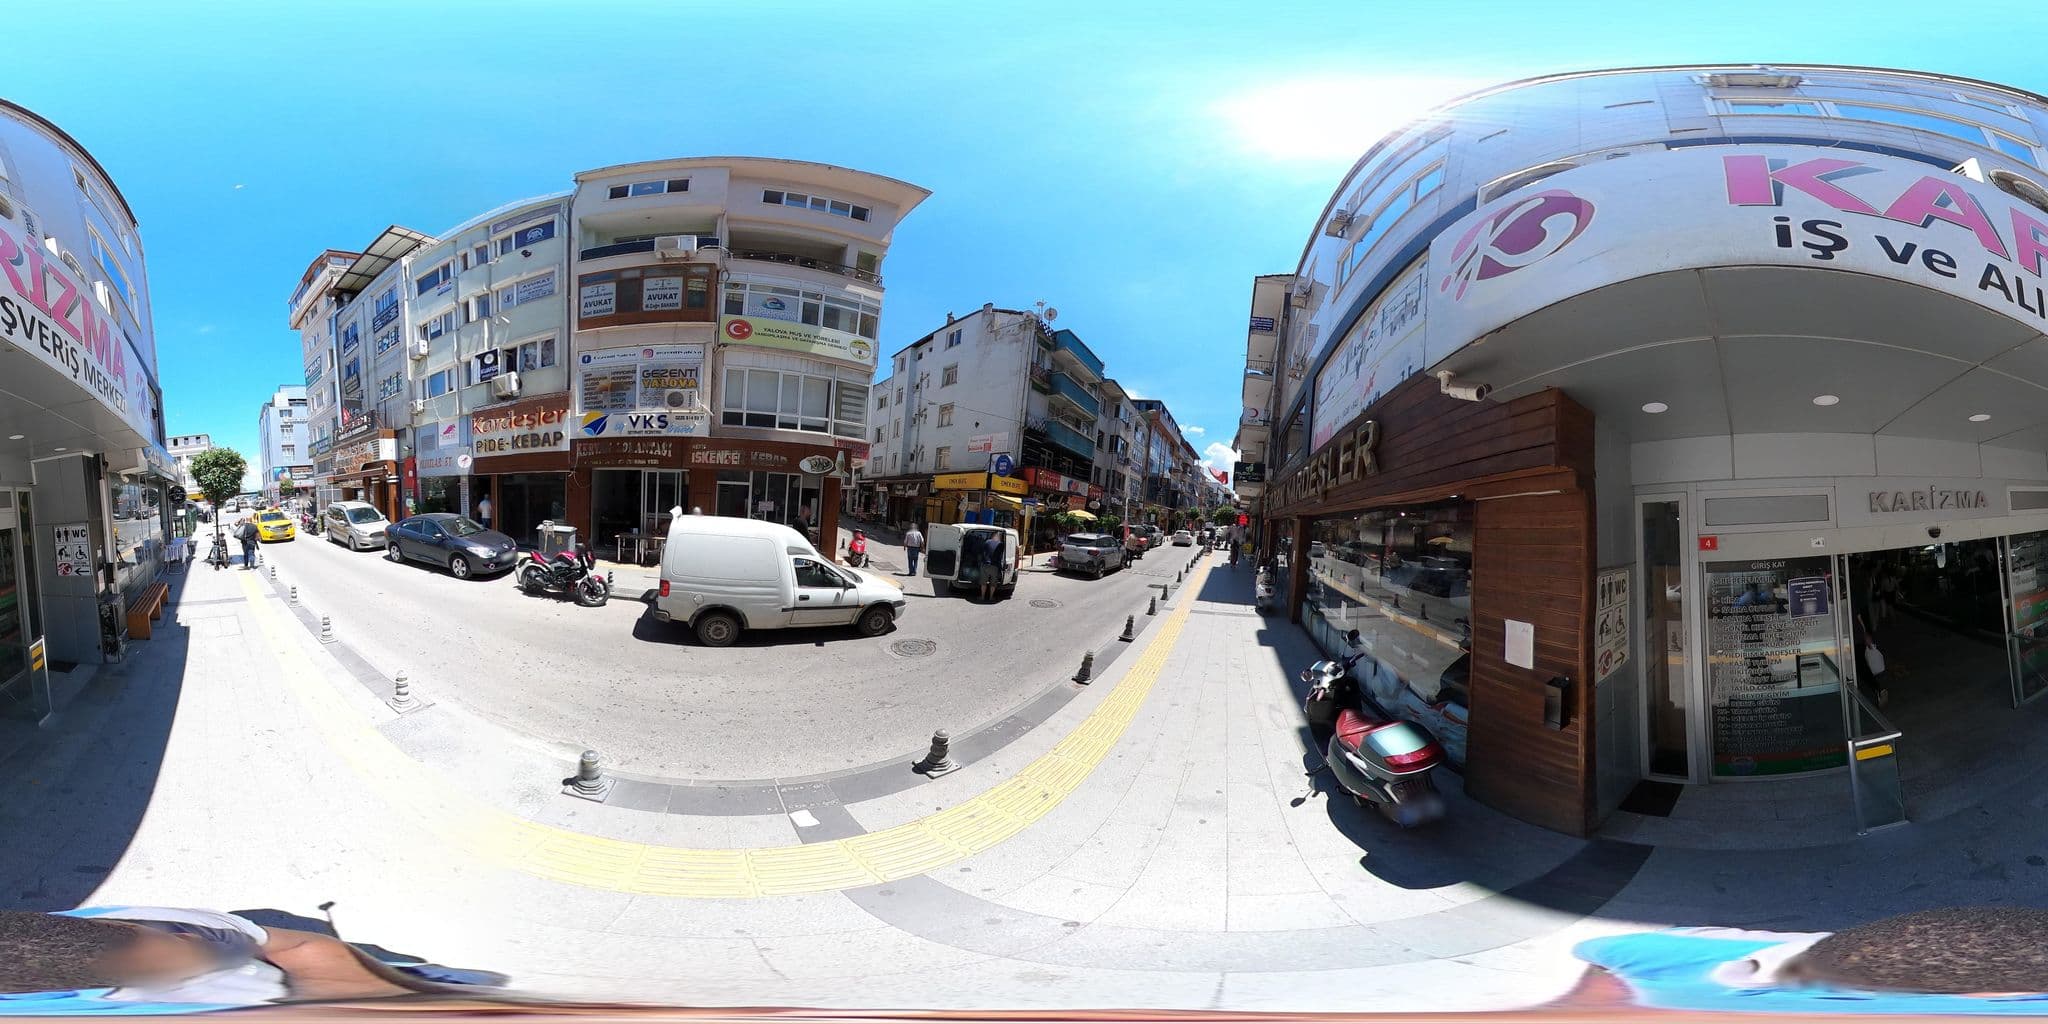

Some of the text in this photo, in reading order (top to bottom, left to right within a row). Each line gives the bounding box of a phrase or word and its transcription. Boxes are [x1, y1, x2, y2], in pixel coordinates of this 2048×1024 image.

[1874, 235, 1957, 278] ve
[647, 292, 678, 302] AVUKAT
[584, 298, 613, 309] AVUKAT
[641, 378, 698, 389] YALOVA
[473, 406, 570, 434] Kardeşler
[628, 414, 668, 430] VKS
[1868, 485, 1988, 513] KARİZMA
[72, 529, 87, 539] WC
[1705, 539, 1712, 547] 4
[1772, 560, 1786, 568] KAT
[1615, 578, 1627, 596] WC
